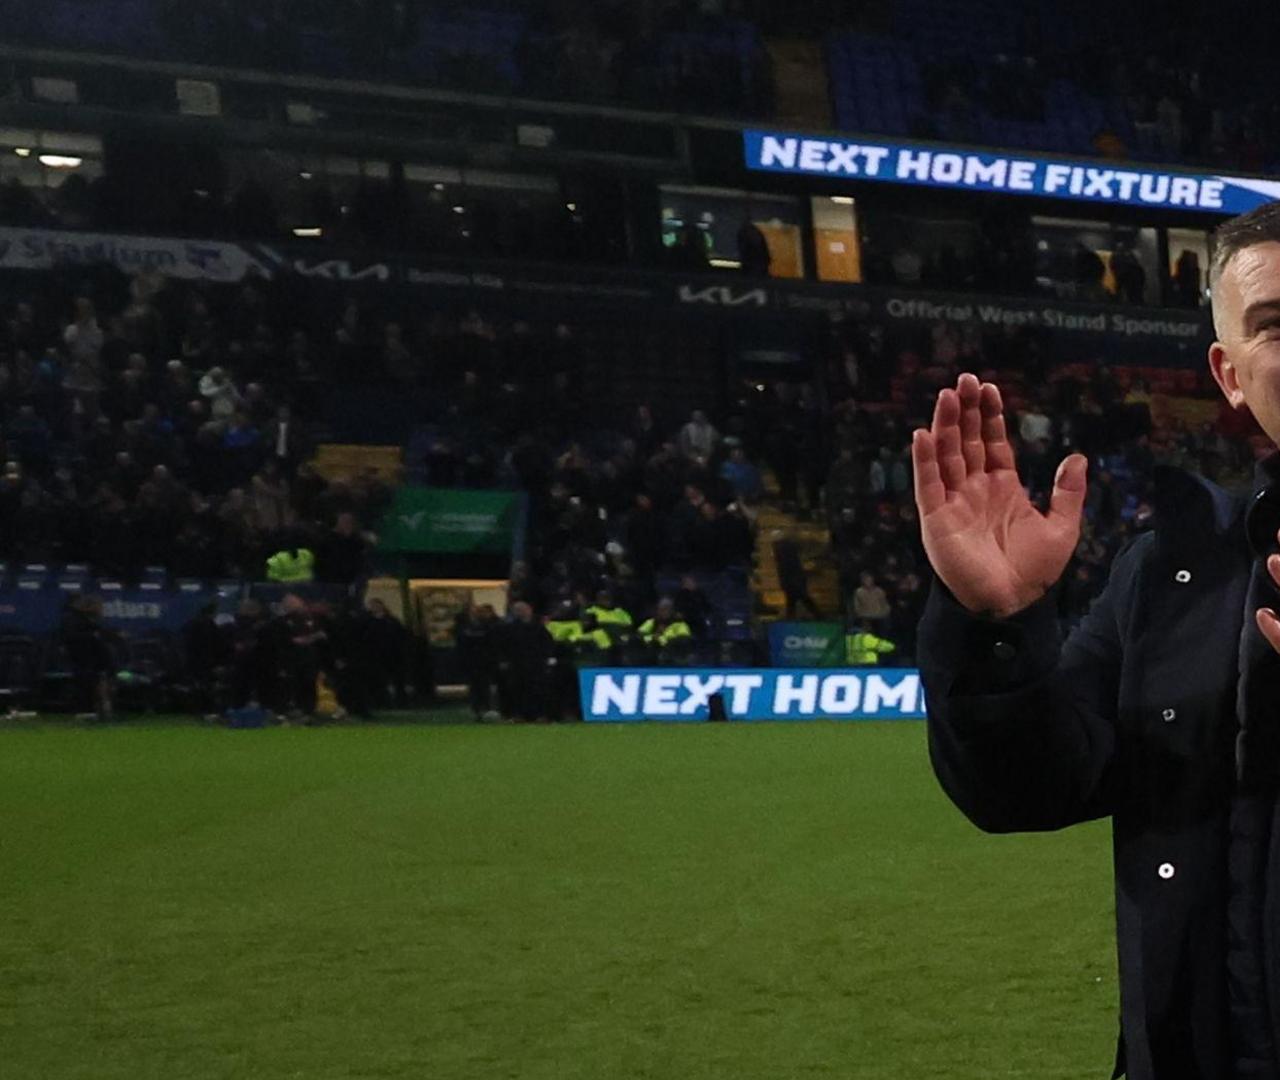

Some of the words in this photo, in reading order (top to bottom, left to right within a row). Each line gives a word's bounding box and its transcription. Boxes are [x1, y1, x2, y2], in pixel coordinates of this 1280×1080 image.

[761, 136, 889, 177] NEXT
[896, 149, 1036, 190] HOME
[1043, 163, 1226, 209] FIXTURE
[886, 297, 970, 322] Official
[1042, 307, 1106, 332] Stand
[1112, 312, 1200, 339] Sponsor
[591, 674, 763, 715] NEXT
[773, 674, 927, 715] HOM
